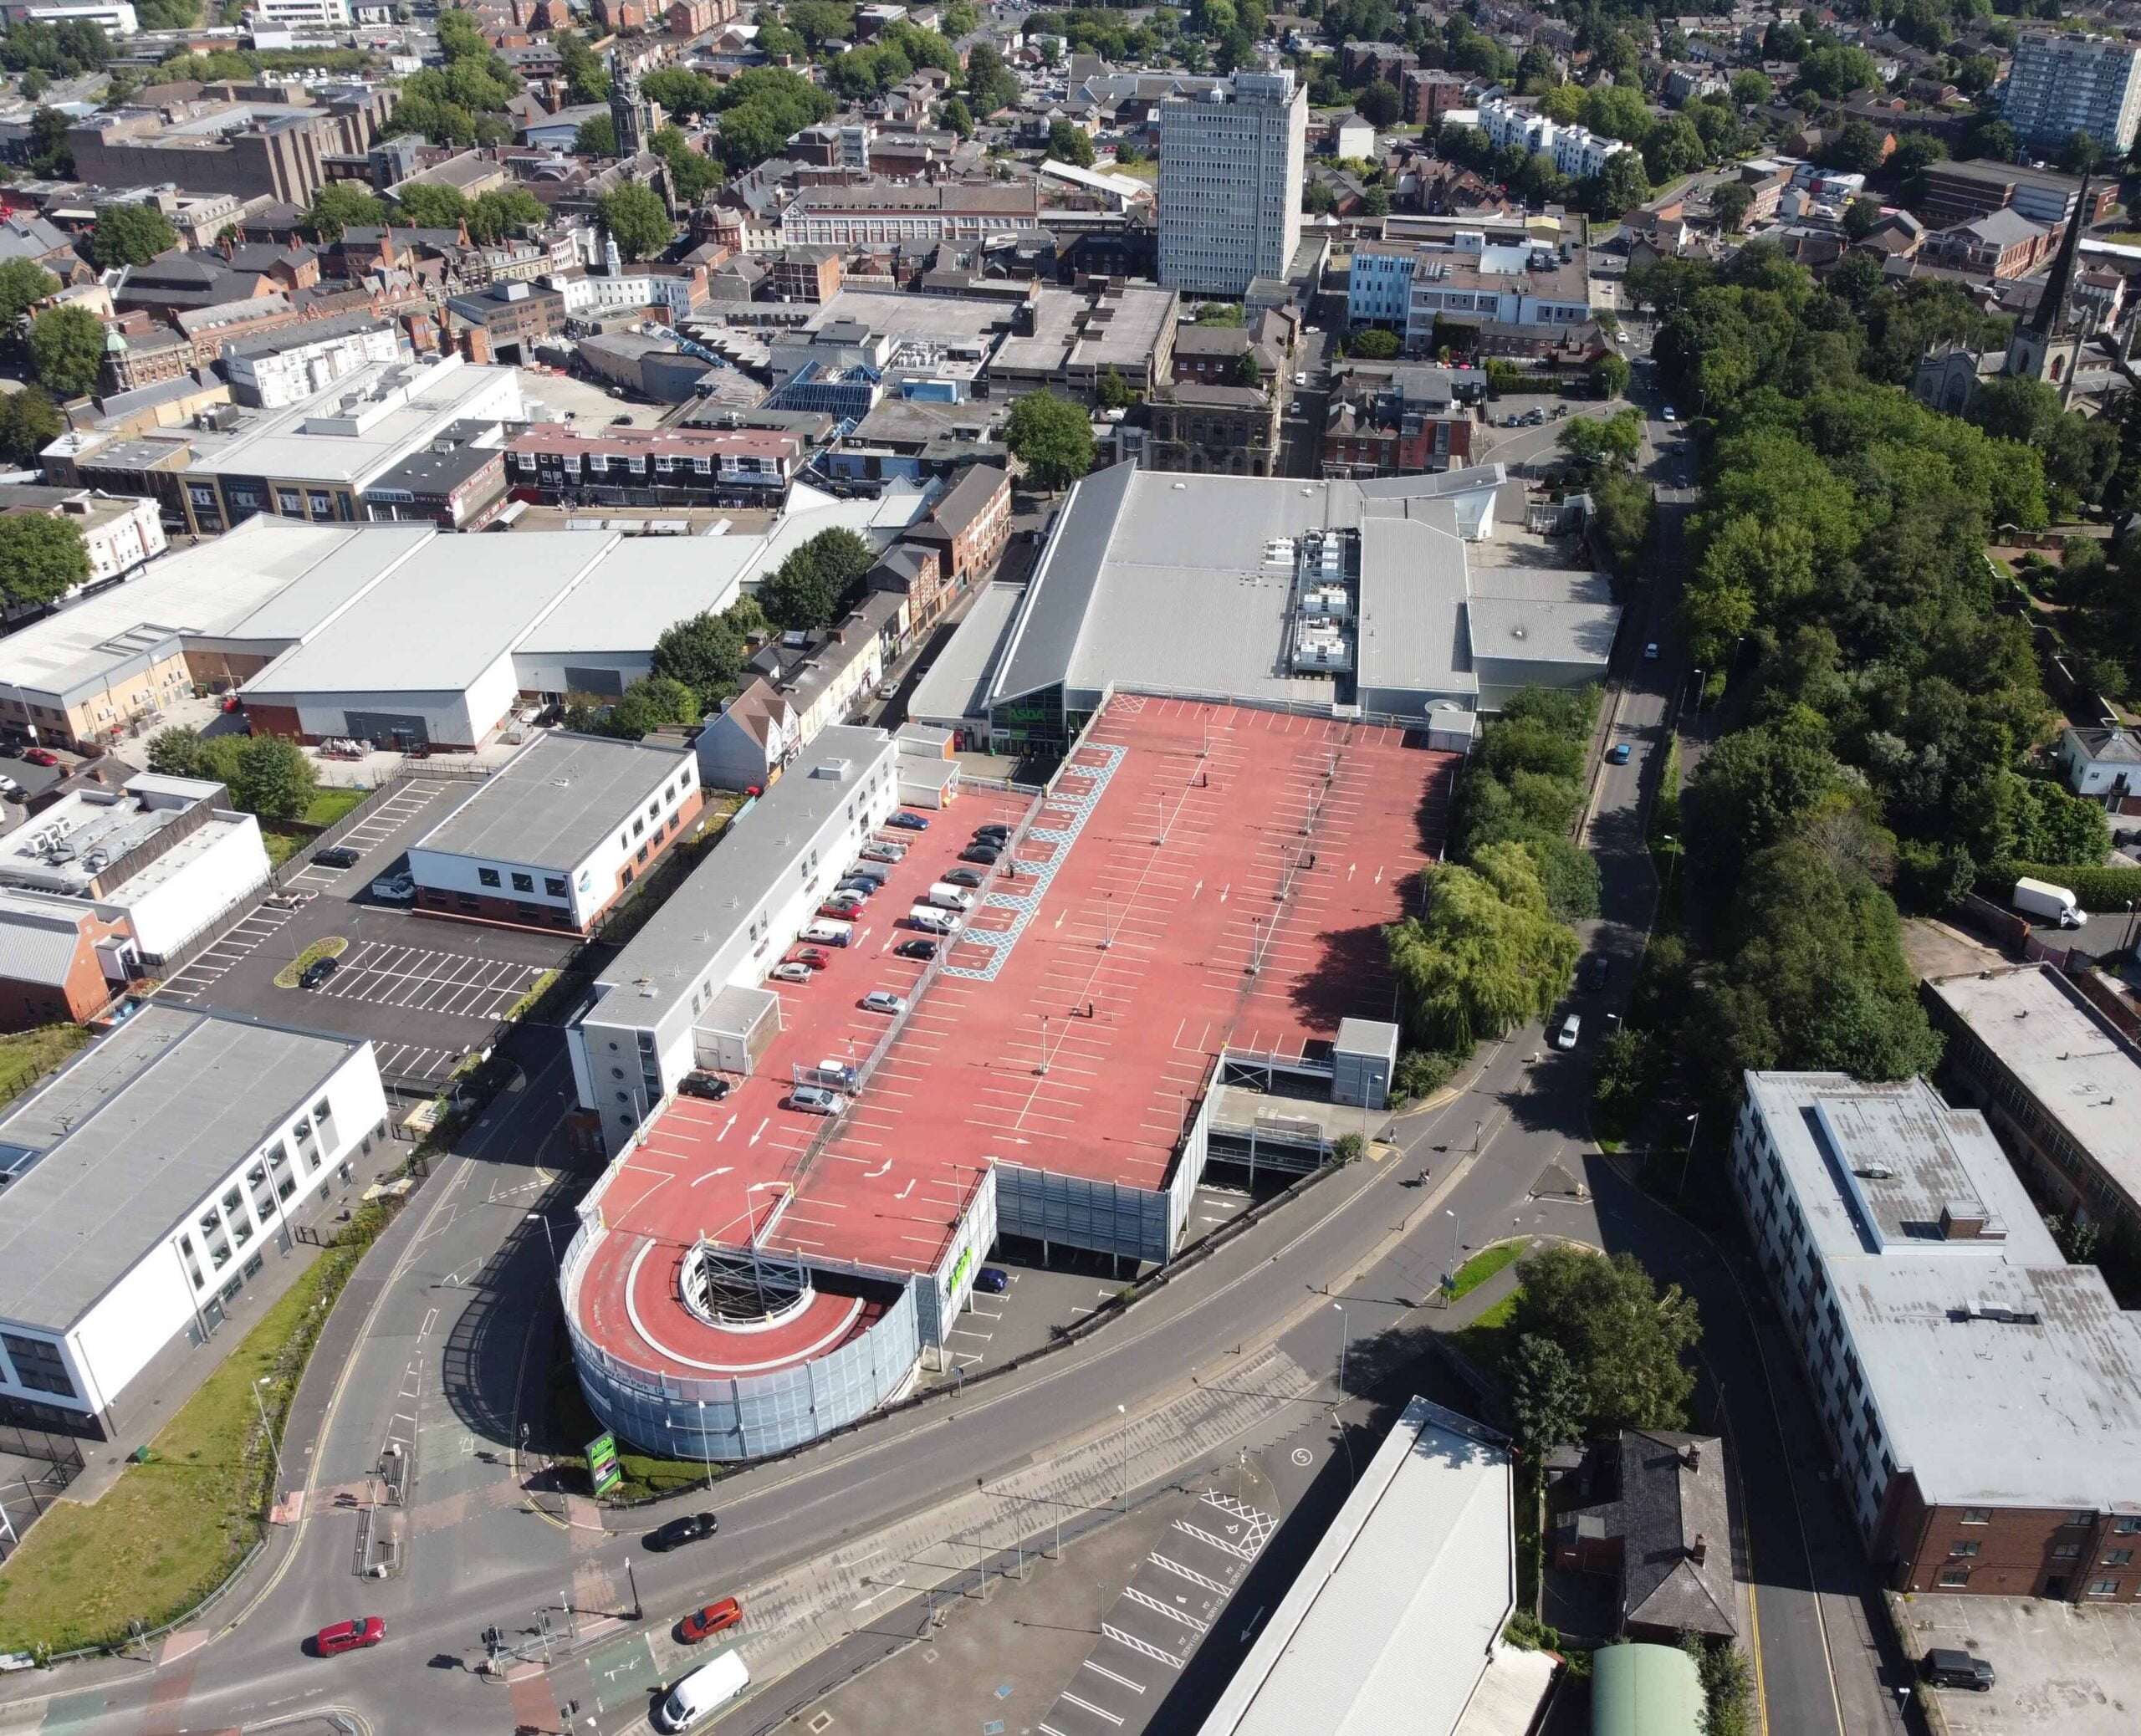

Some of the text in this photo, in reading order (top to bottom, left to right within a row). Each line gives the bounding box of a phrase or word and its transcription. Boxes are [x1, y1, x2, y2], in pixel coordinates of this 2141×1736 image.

[1009, 707, 1045, 720] ASDA
[617, 1374, 630, 1383] Car
[631, 1380, 648, 1389] Park
[591, 1437, 614, 1453] ASDA
[1229, 1561, 1248, 1585] SERVICE
[1205, 1596, 1224, 1621] SERVICE
[1181, 1632, 1201, 1657] SERVICE
